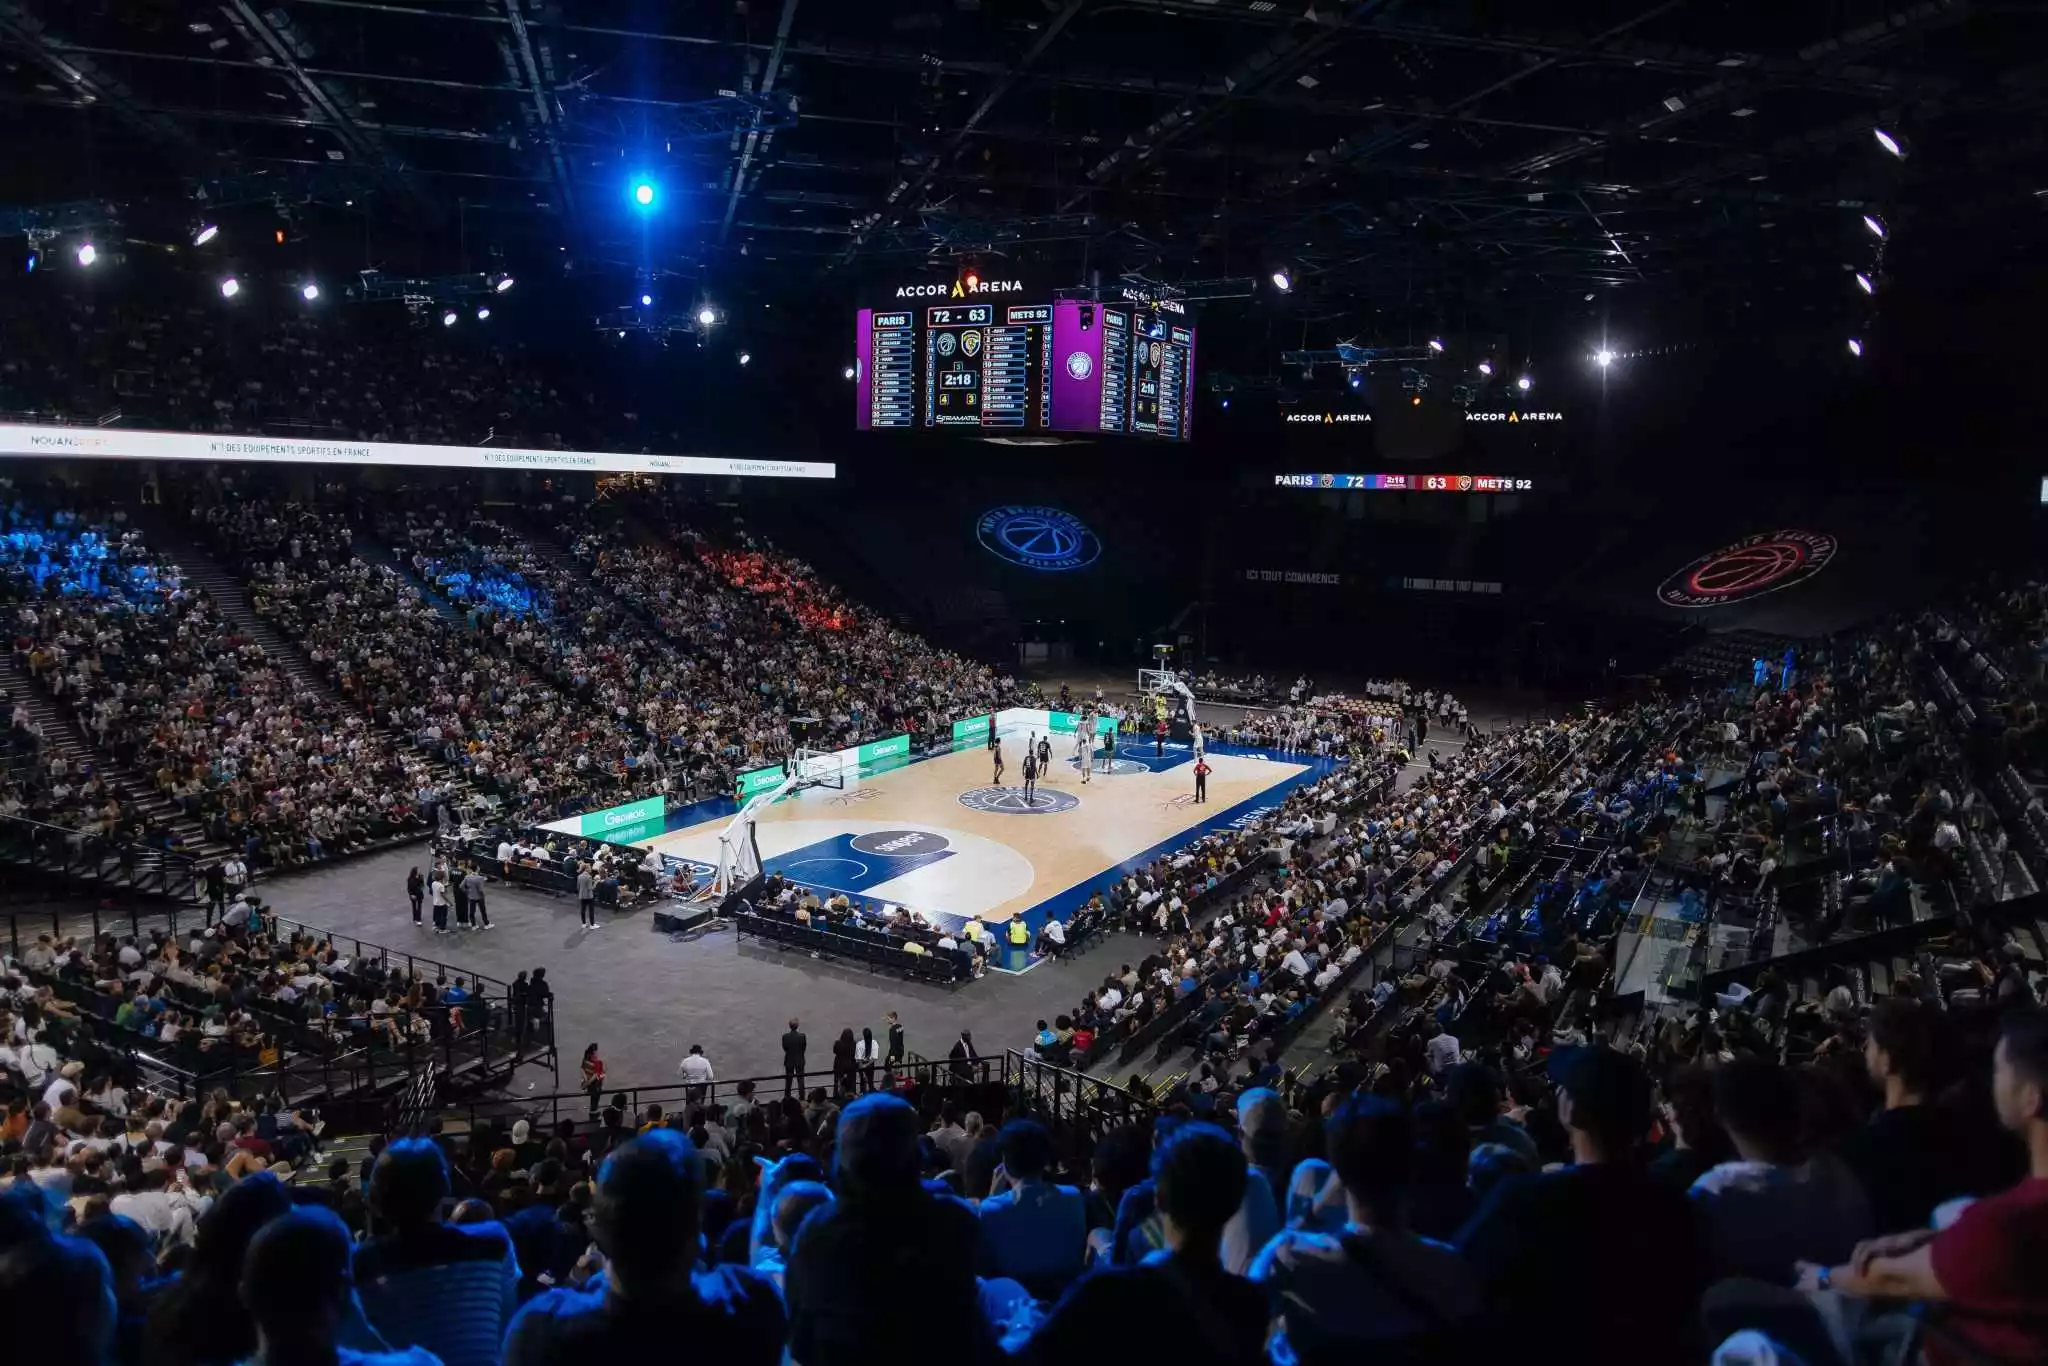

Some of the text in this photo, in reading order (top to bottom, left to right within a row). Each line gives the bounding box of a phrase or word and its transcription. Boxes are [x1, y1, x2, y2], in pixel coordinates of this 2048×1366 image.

[896, 285, 947, 297] ACCOR
[969, 280, 1023, 293] ARENA
[933, 311, 950, 323] 72
[968, 309, 986, 321] 63
[1010, 310, 1047, 319] METS 92
[1106, 313, 1122, 326] PARIS
[878, 316, 906, 325] PARIS
[945, 374, 971, 385] 2:18
[1141, 383, 1155, 395] 2:18
[942, 395, 947, 403] 4
[1287, 414, 1321, 422] ACCOR
[1522, 412, 1563, 420] ARENA
[226, 443, 241, 452] DES
[297, 446, 331, 455] SPORTIFS
[344, 448, 370, 456] FRANCE
[1275, 475, 1313, 485] PARIS
[1347, 476, 1364, 487] 72
[1427, 477, 1447, 488] 63
[1477, 479, 1532, 489] METS 92
[1260, 570, 1282, 581] TOUT
[1285, 571, 1340, 584] COMMENCE
